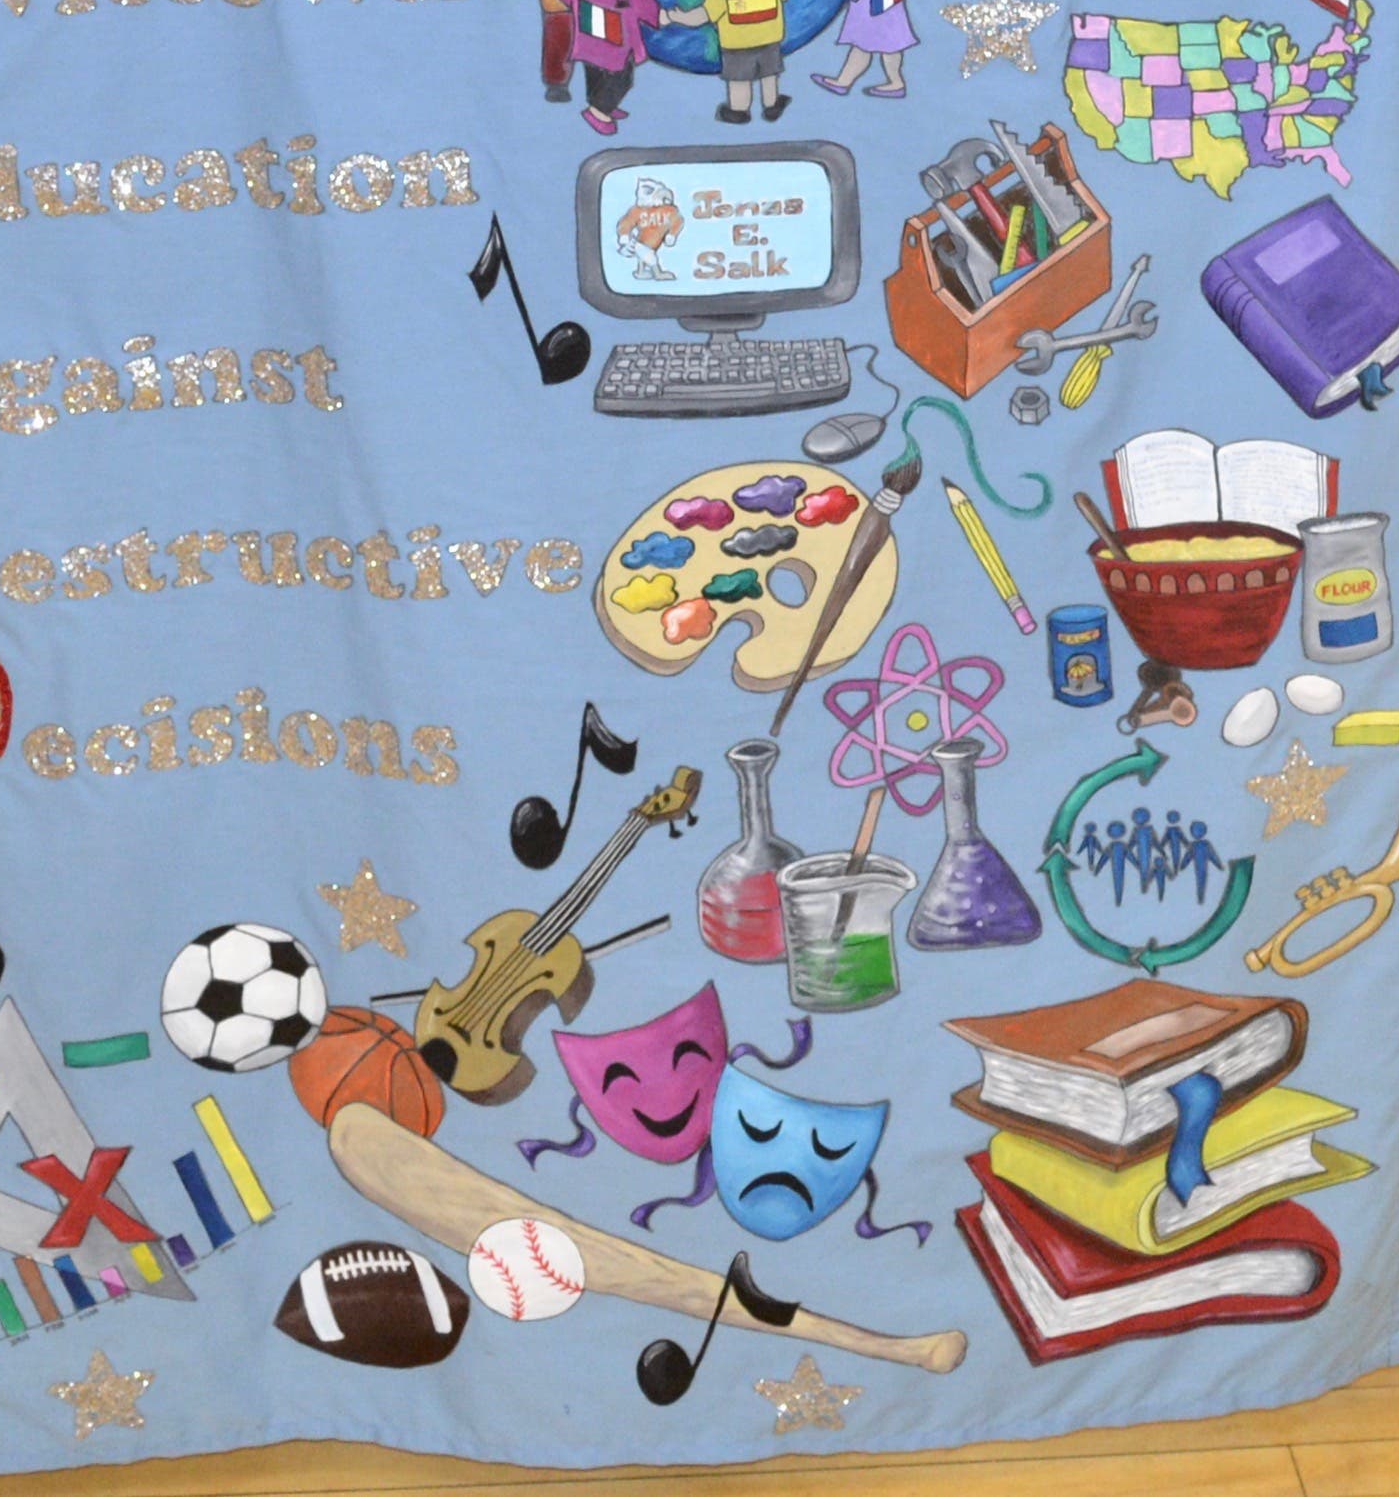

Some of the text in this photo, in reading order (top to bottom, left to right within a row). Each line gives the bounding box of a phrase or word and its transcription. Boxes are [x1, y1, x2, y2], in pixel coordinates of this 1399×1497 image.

[692, 190, 804, 220] Jonas
[639, 210, 673, 228] SALK
[732, 223, 769, 246] E.
[692, 251, 791, 280] Salk
[1321, 580, 1371, 599] FLOUR
